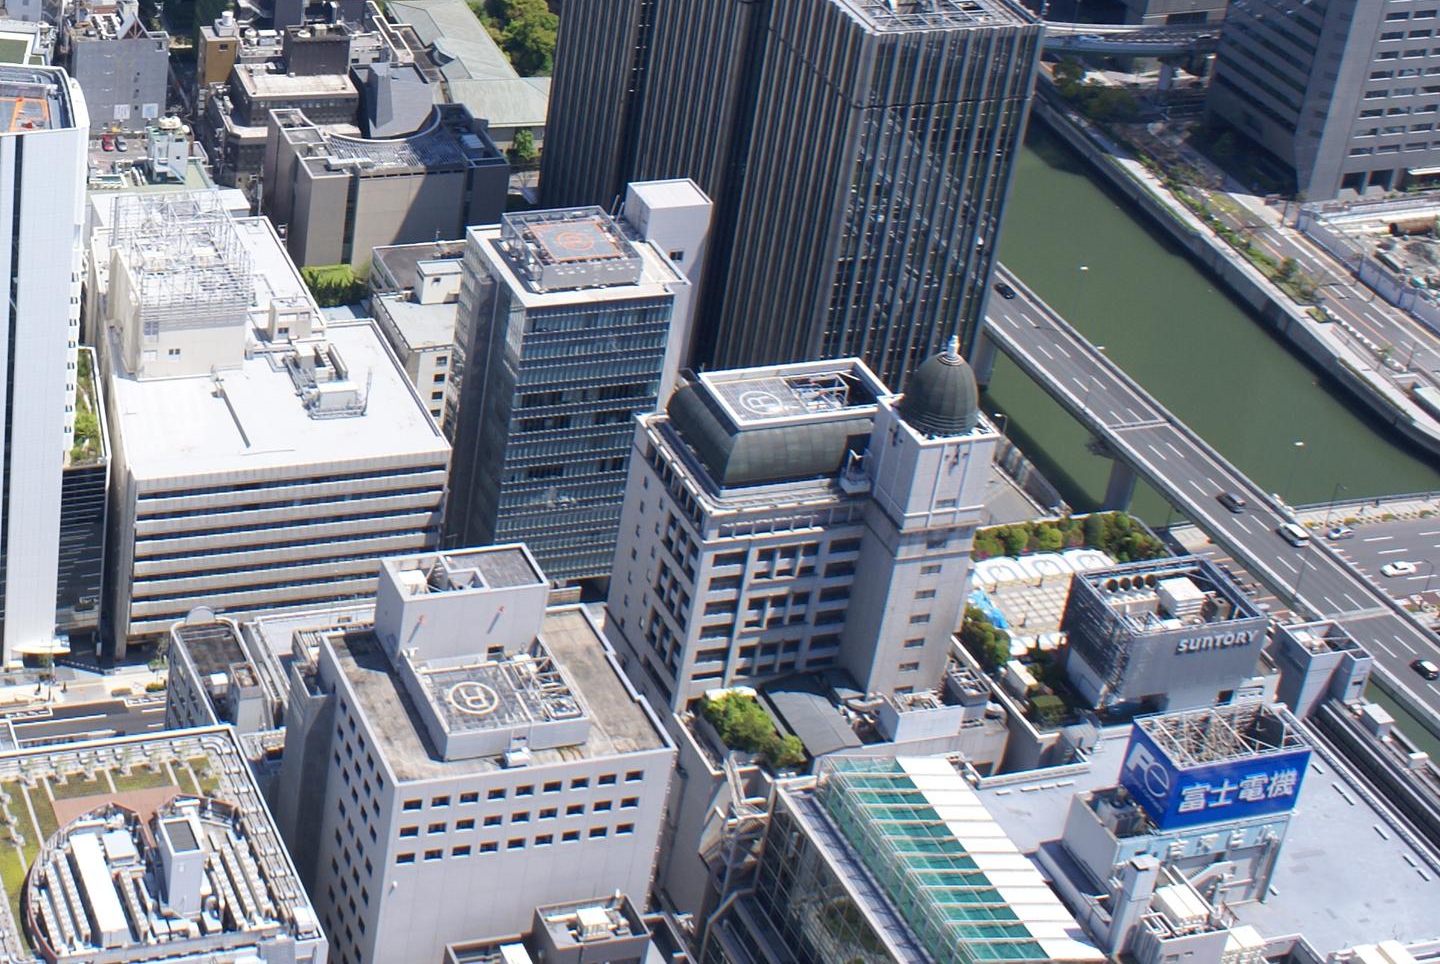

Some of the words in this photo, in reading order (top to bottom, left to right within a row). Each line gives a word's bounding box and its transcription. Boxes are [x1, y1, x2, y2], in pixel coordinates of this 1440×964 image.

[459, 686, 490, 709] R
[1177, 767, 1299, 813] 富士電機
